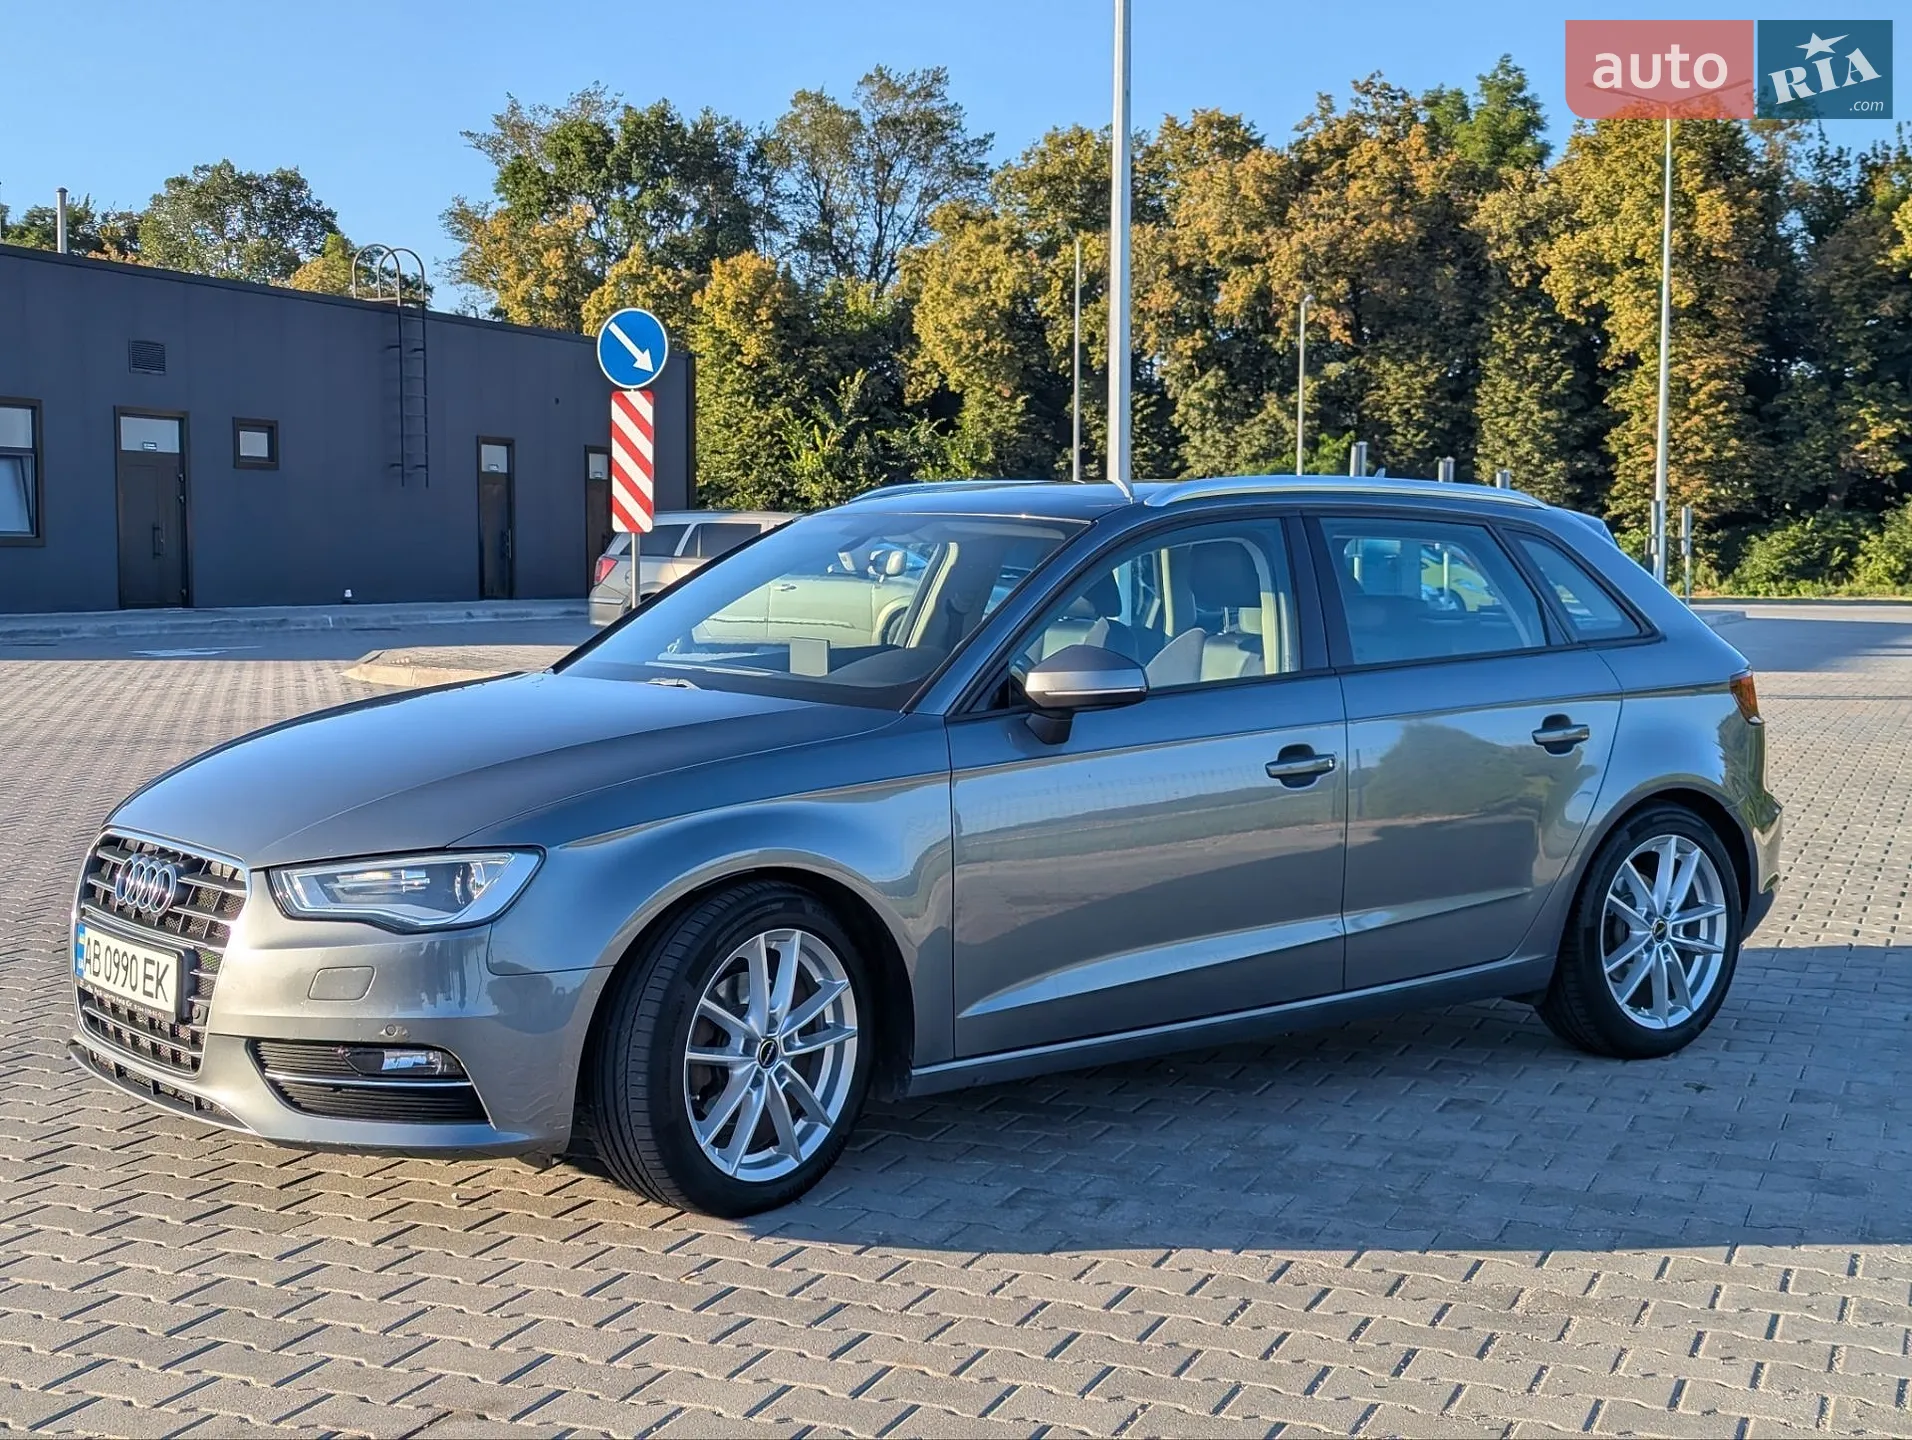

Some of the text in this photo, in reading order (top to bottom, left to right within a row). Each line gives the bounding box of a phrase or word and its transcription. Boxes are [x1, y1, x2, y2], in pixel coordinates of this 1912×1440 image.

[84, 937, 101, 977] AB
[104, 945, 138, 992] 0990
[142, 957, 169, 1003] EK
